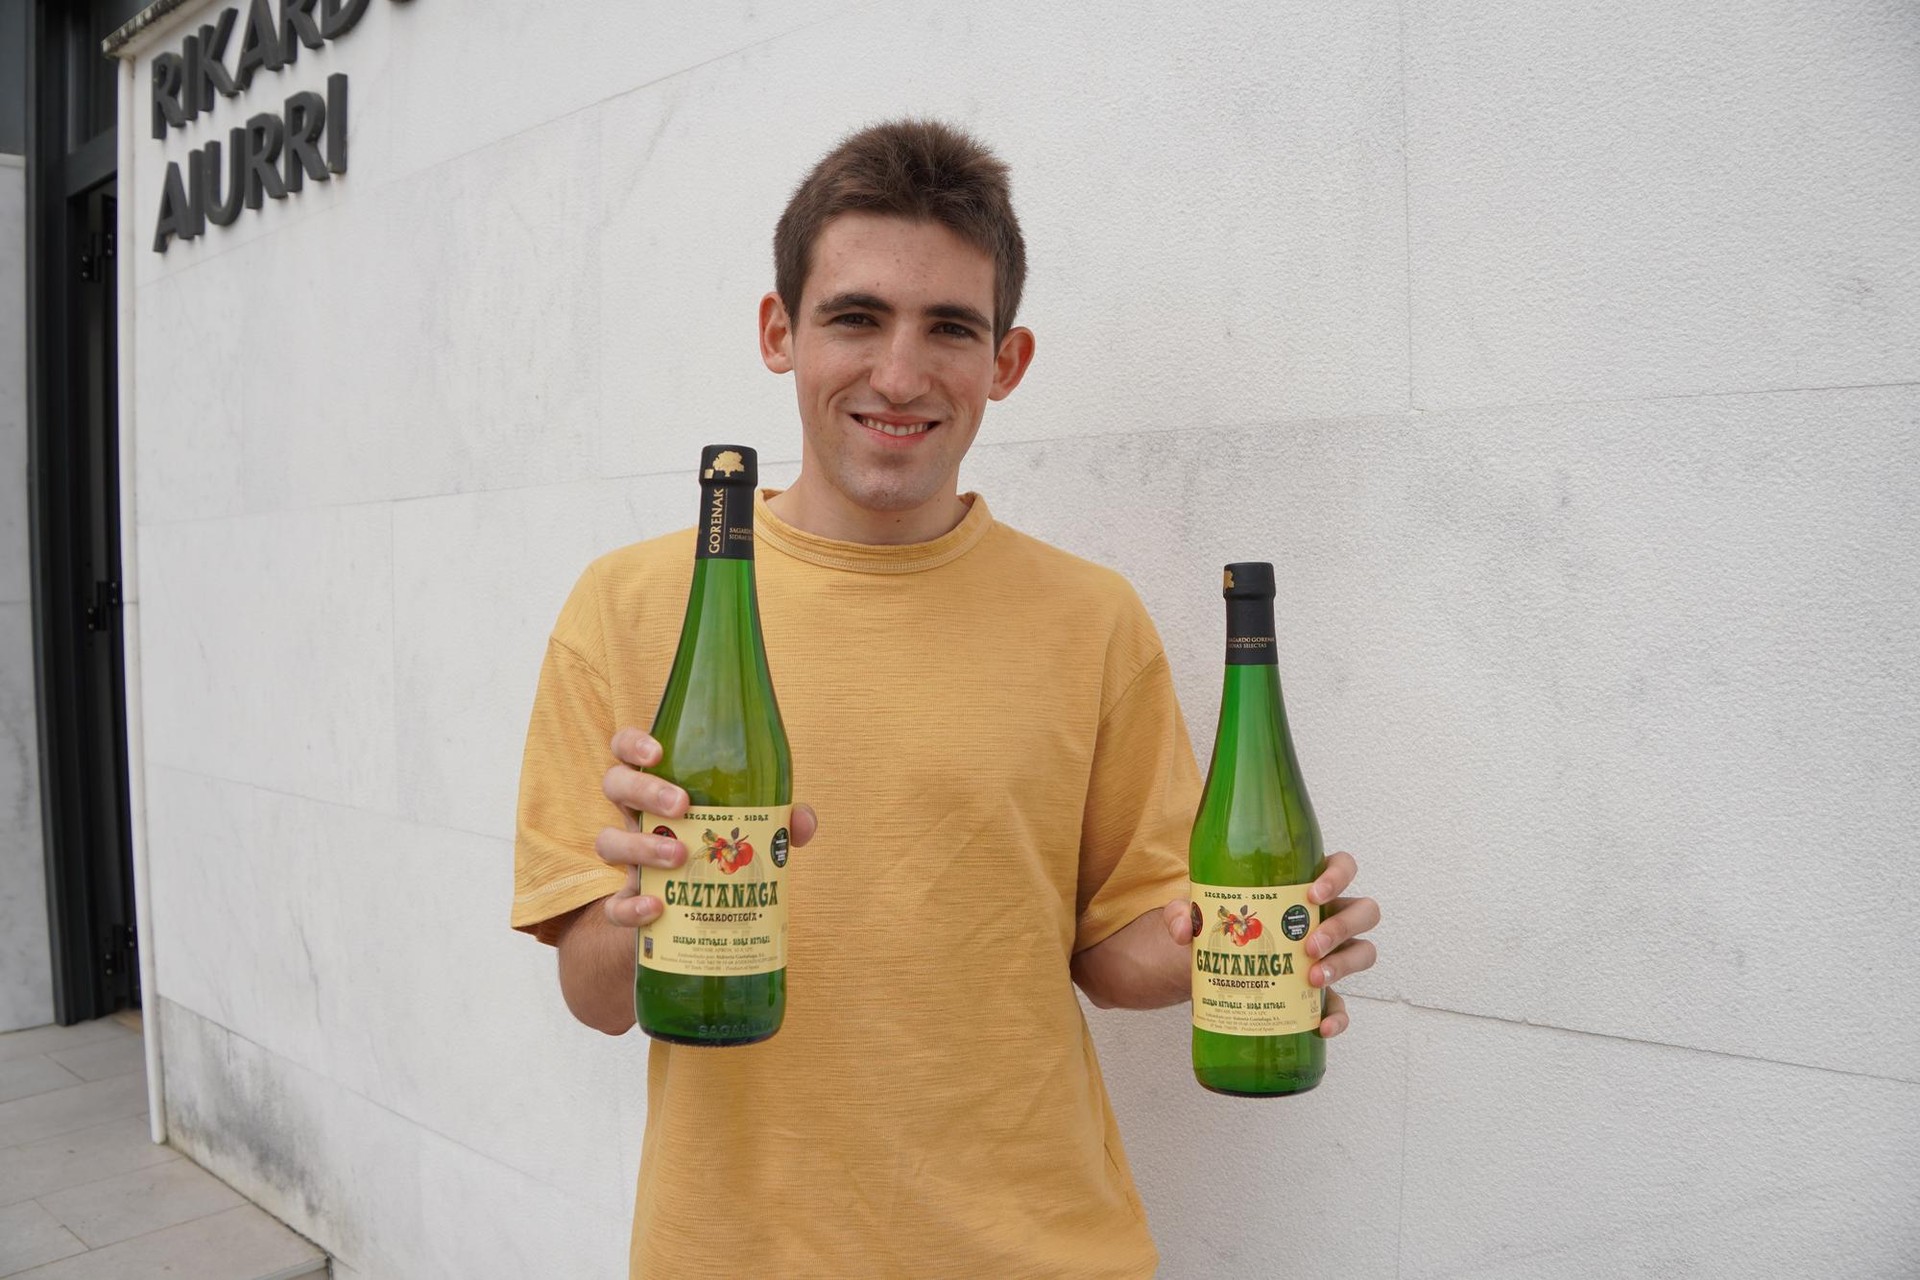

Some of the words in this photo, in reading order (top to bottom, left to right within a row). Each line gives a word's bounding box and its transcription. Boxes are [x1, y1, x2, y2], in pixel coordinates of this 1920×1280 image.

[152, 0, 415, 139] RIKAR
[153, 73, 348, 253] AIURRI
[709, 488, 724, 554] GORENAK
[690, 912, 758, 922] SAGARDOTEGIA
[1212, 978, 1270, 989] SAGARDOTEGIA
